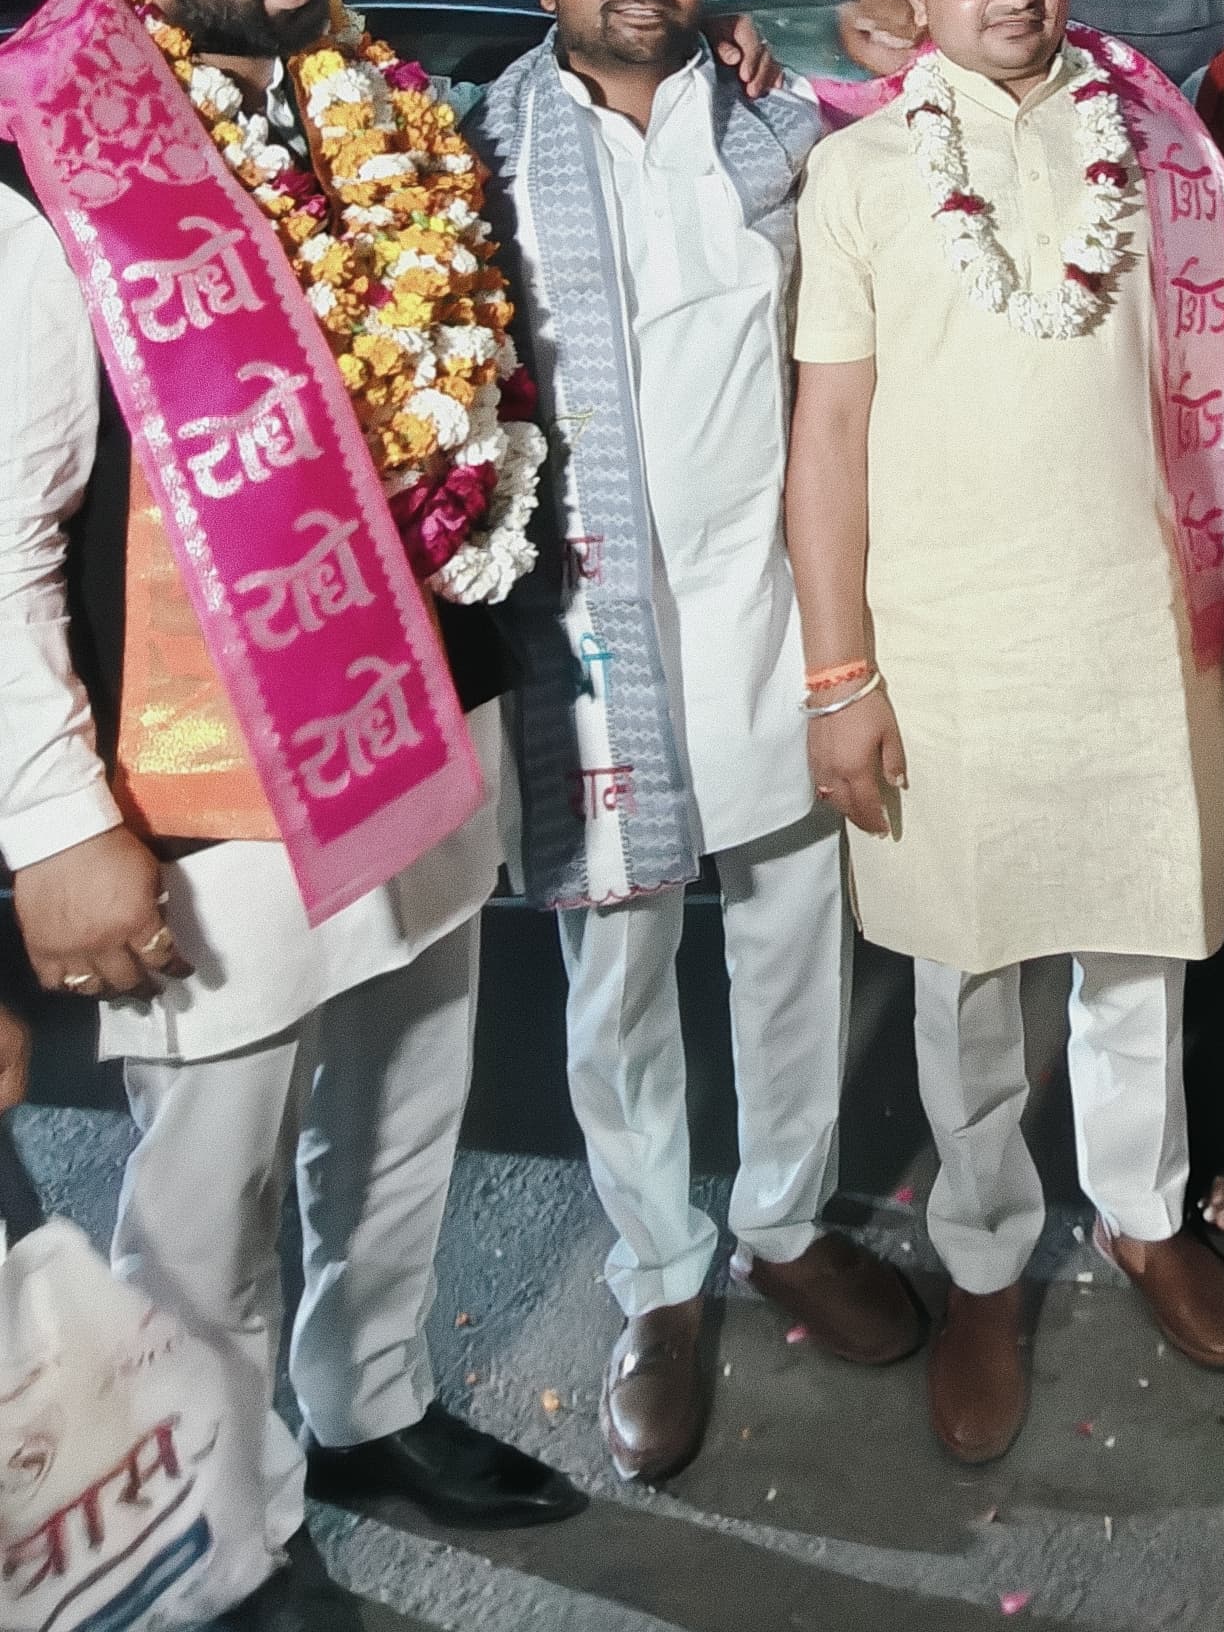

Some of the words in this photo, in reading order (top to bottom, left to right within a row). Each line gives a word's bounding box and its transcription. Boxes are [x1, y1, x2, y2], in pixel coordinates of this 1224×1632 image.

[122, 216, 266, 344] राधे
[179, 362, 322, 500] राधे
[236, 511, 377, 651] राधे
[290, 657, 422, 799] राधे
